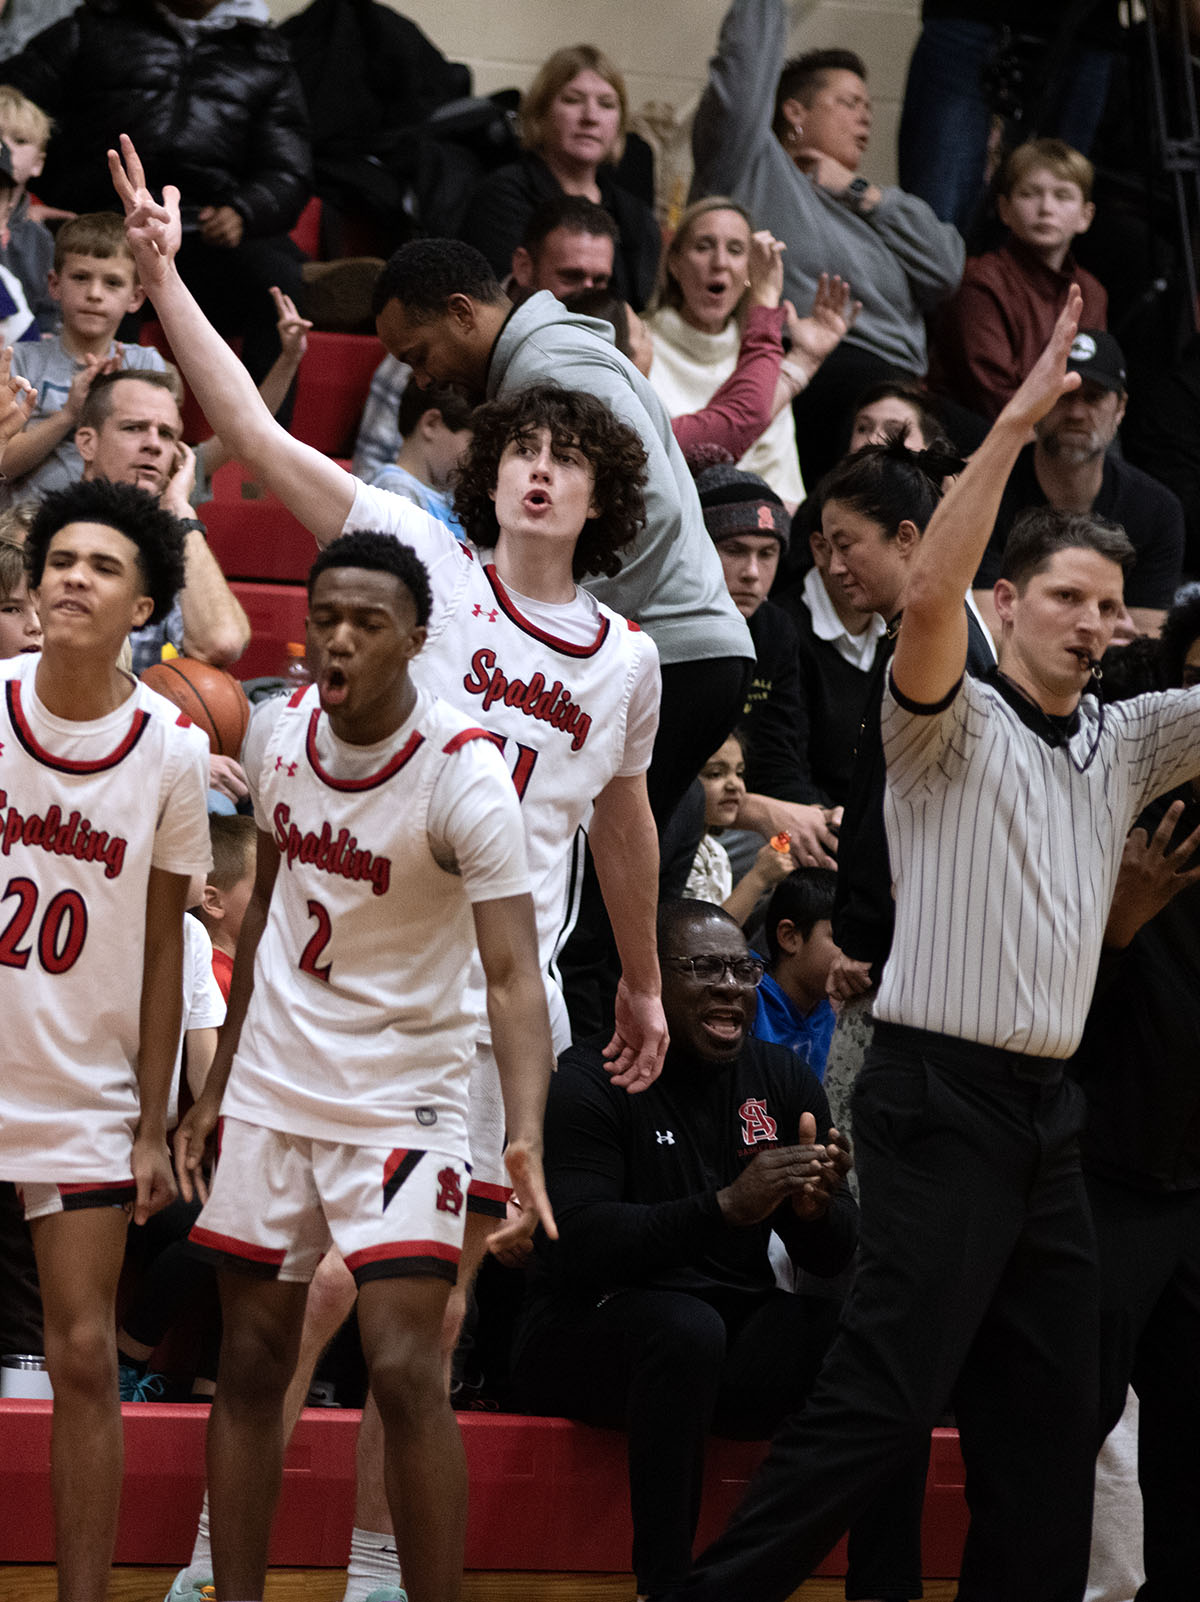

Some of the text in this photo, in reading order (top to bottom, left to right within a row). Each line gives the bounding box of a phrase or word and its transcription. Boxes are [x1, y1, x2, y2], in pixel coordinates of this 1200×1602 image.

[464, 648, 593, 752] Spalding
[274, 802, 392, 896] Spalding
[298, 900, 333, 983] 2
